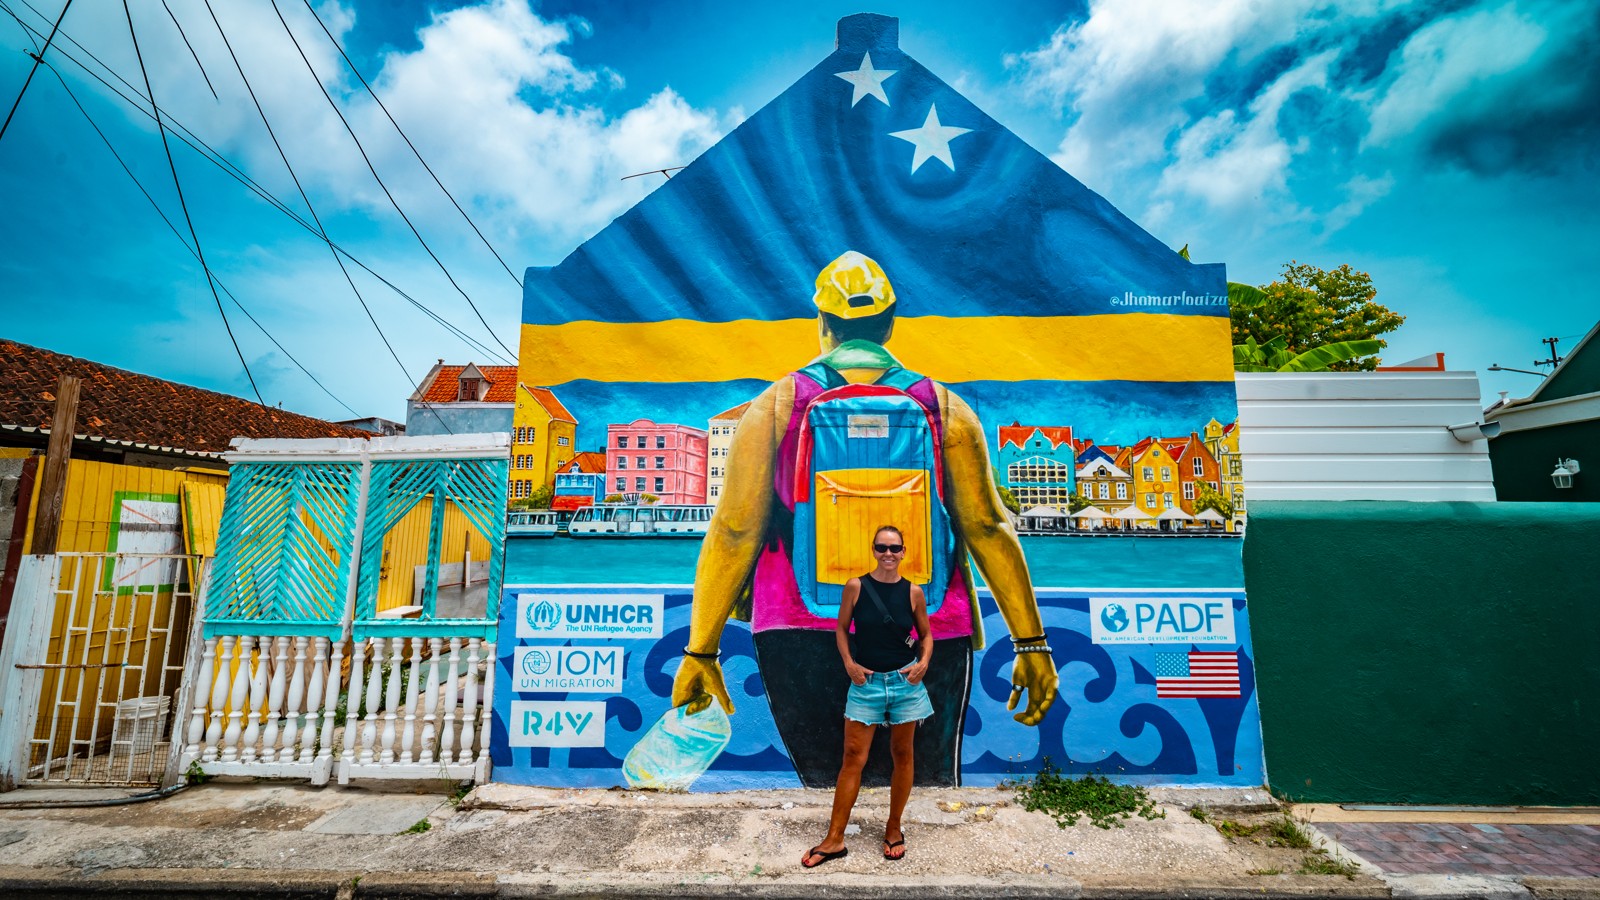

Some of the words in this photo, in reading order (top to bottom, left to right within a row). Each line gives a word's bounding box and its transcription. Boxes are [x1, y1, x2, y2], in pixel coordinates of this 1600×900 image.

[566, 604, 653, 624] UNHCR
[1135, 603, 1224, 633] PADF
[565, 624, 579, 632] The
[581, 624, 592, 632] UN
[594, 624, 623, 633] Refugee
[625, 625, 653, 634] Agency
[557, 650, 616, 675] IOM
[521, 678, 540, 688] UN
[545, 678, 614, 688] MIGRATION
[522, 710, 593, 736] R4V
